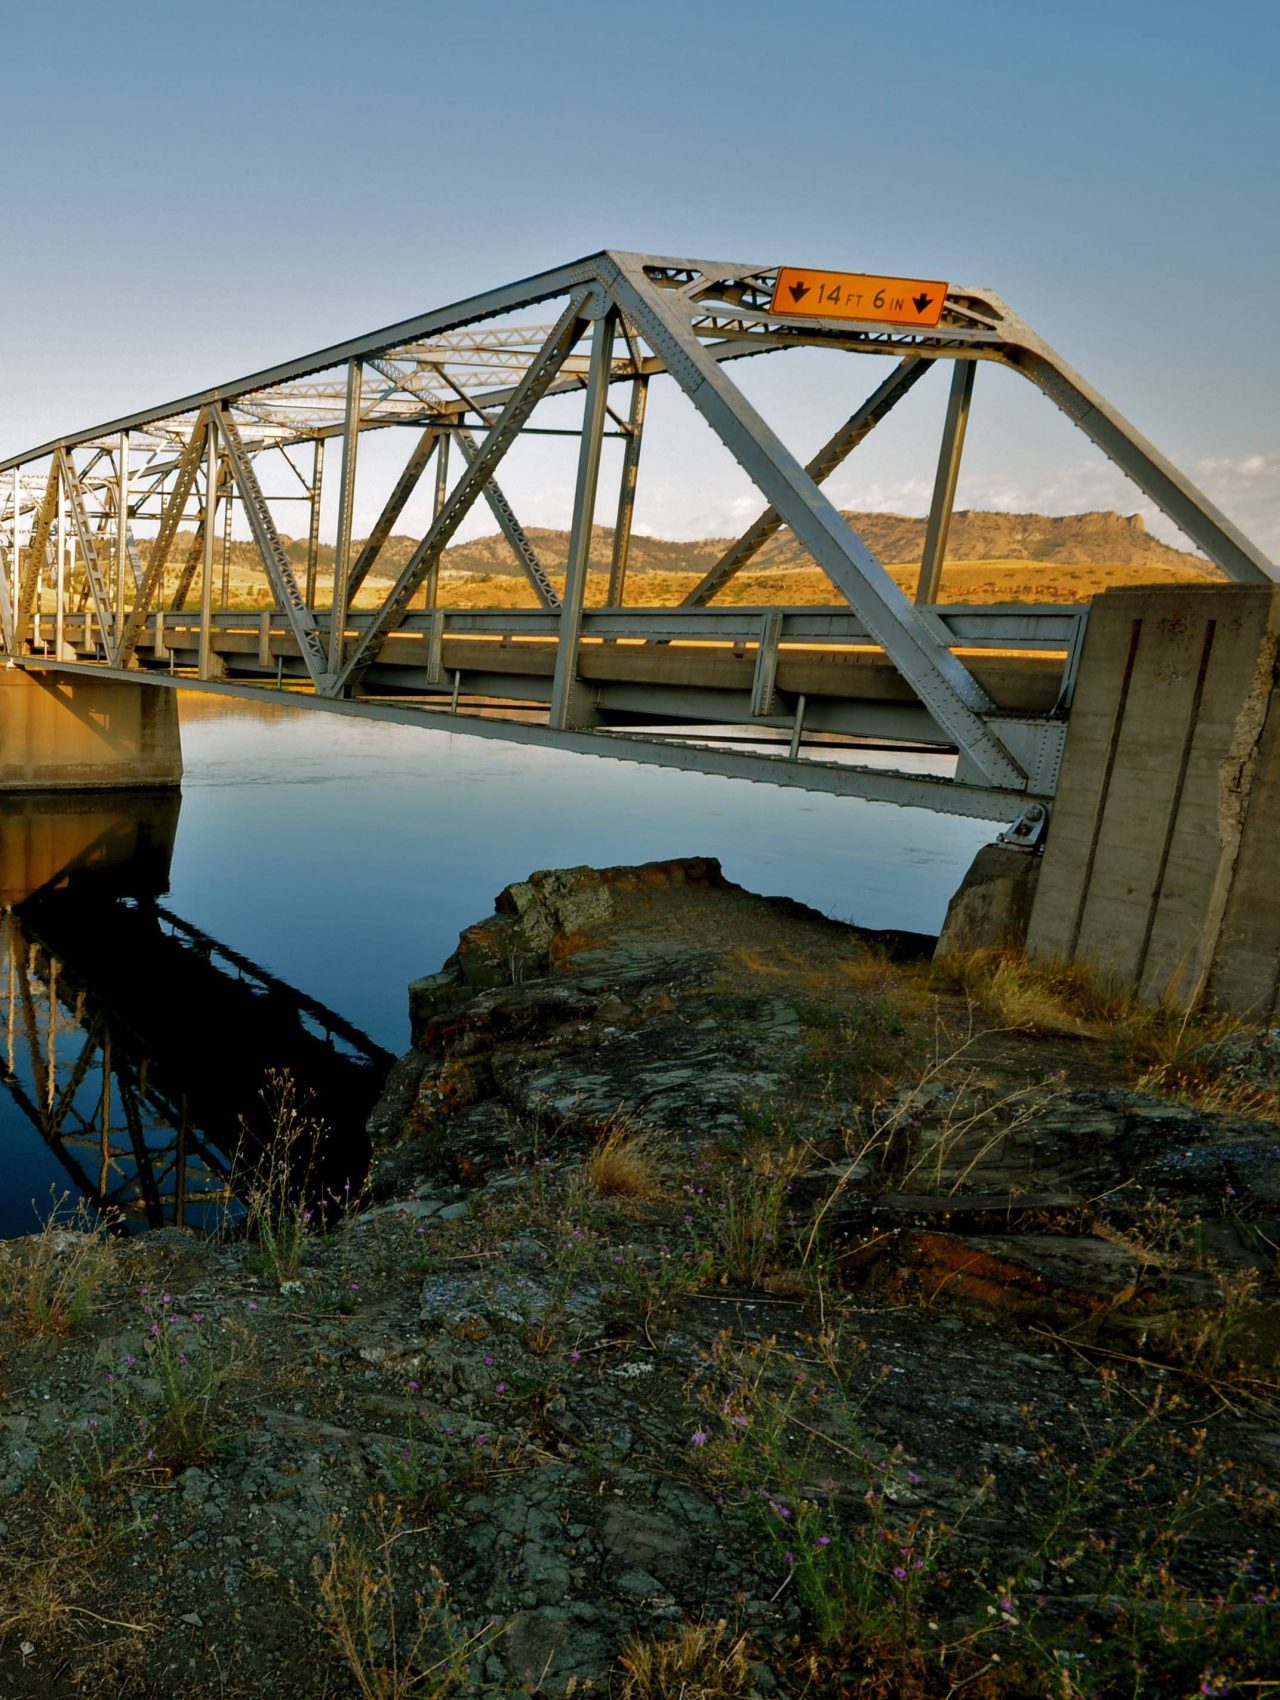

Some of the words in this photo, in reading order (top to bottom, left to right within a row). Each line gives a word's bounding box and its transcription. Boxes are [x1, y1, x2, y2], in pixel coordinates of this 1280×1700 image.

[818, 283, 842, 305] 14
[845, 294, 864, 307] FT
[873, 289, 886, 309] 6
[889, 298, 905, 311] IN
